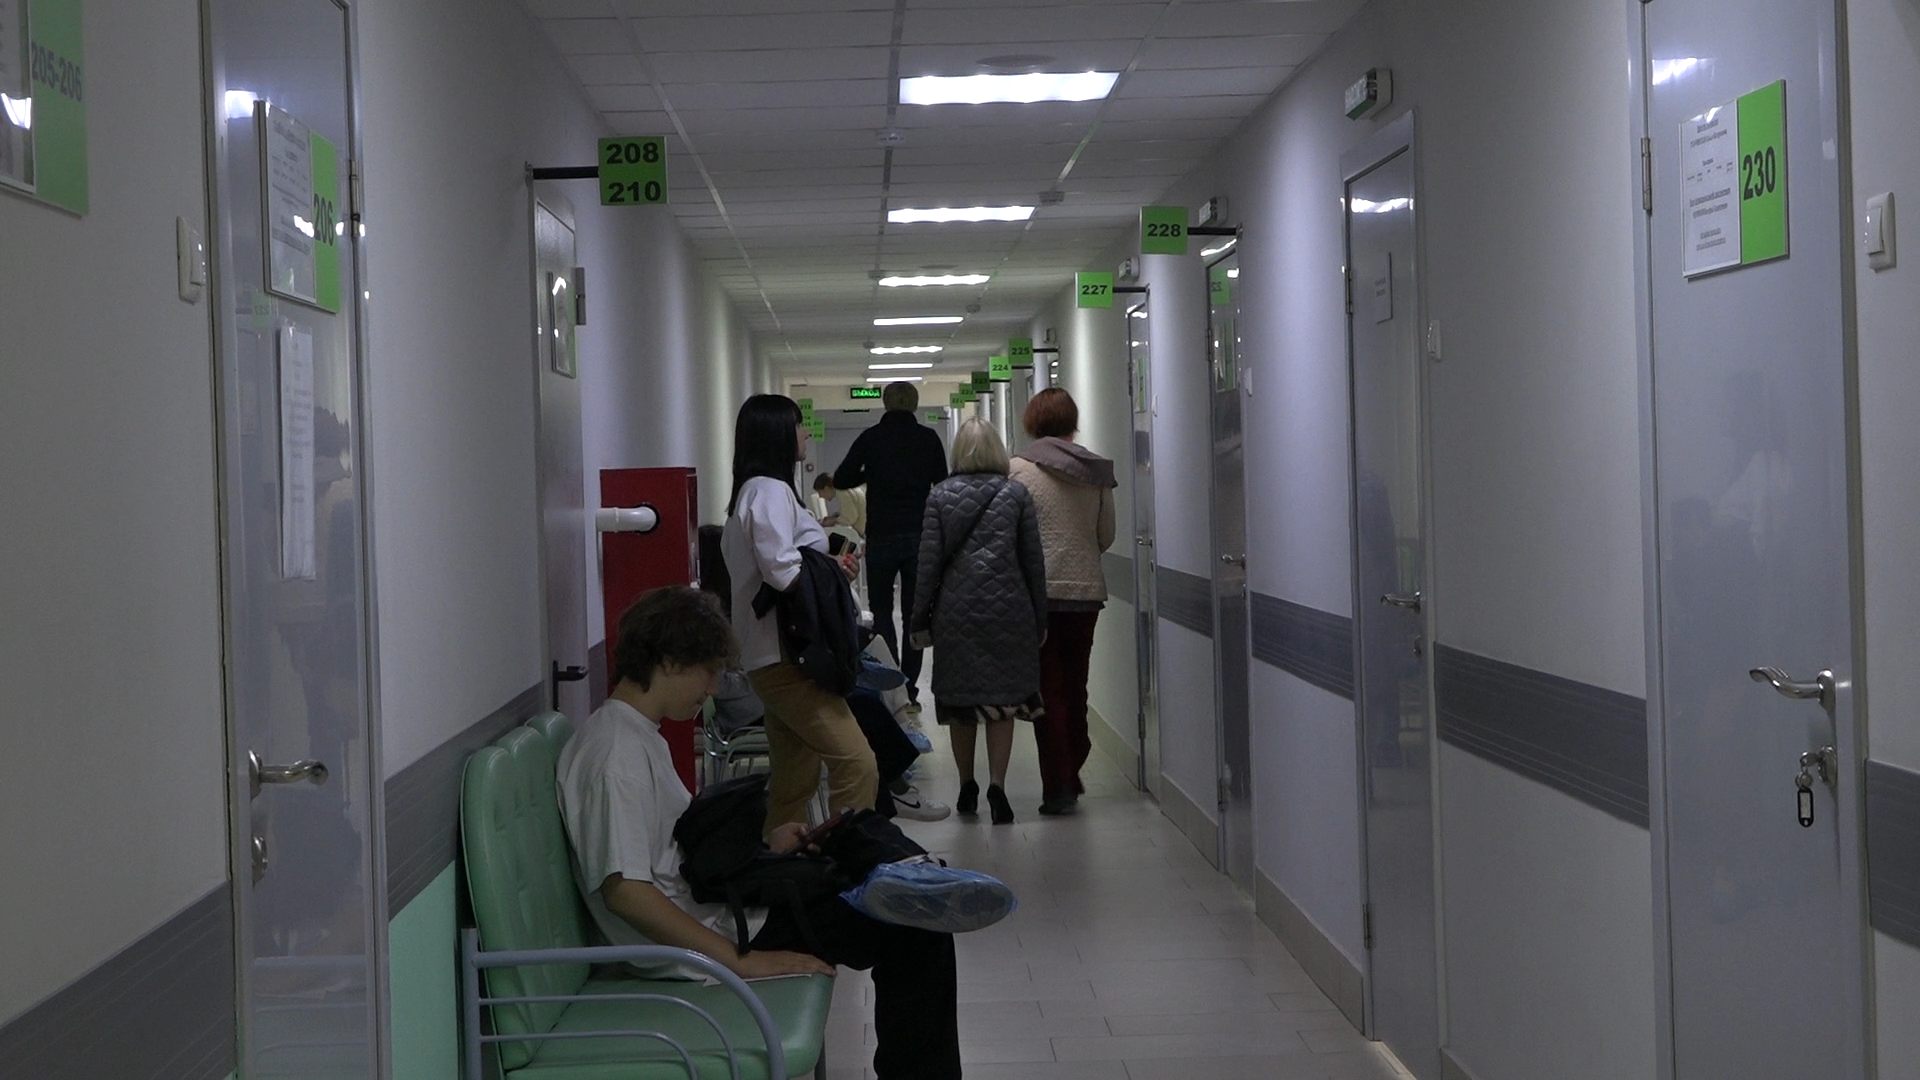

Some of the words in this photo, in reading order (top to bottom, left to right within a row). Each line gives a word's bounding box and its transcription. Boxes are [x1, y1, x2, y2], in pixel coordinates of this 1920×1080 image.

[31, 41, 82, 102] 205-206
[606, 142, 659, 164] 208
[1743, 146, 1775, 201] 230
[608, 181, 661, 203] 210
[313, 193, 334, 247] 206
[1147, 223, 1181, 237] 228
[1081, 284, 1107, 295] 227
[1011, 347, 1030, 355] 225
